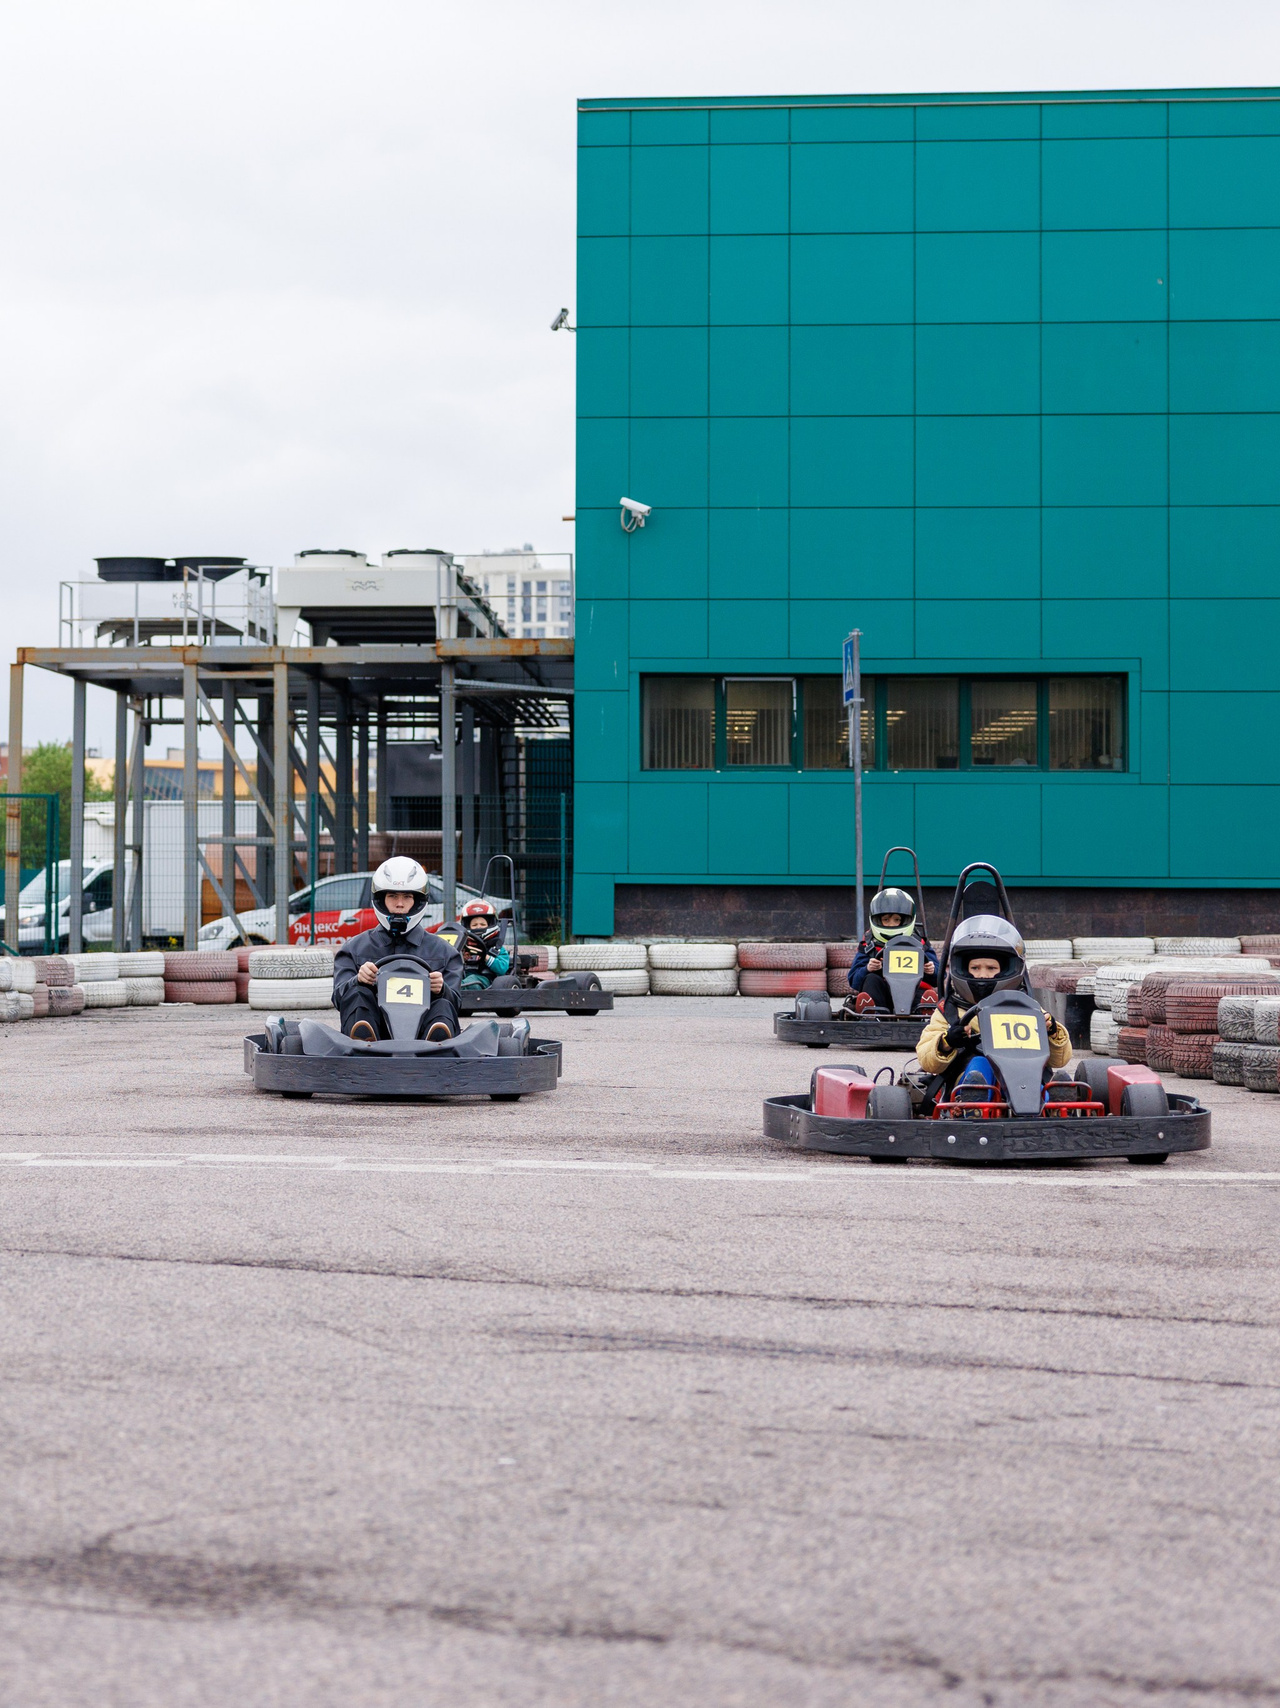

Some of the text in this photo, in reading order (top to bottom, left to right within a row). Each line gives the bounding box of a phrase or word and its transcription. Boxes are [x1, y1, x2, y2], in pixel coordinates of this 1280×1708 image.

[895, 956, 913, 969] 12
[396, 984, 413, 997] 4
[1000, 1022, 1031, 1041] 10
